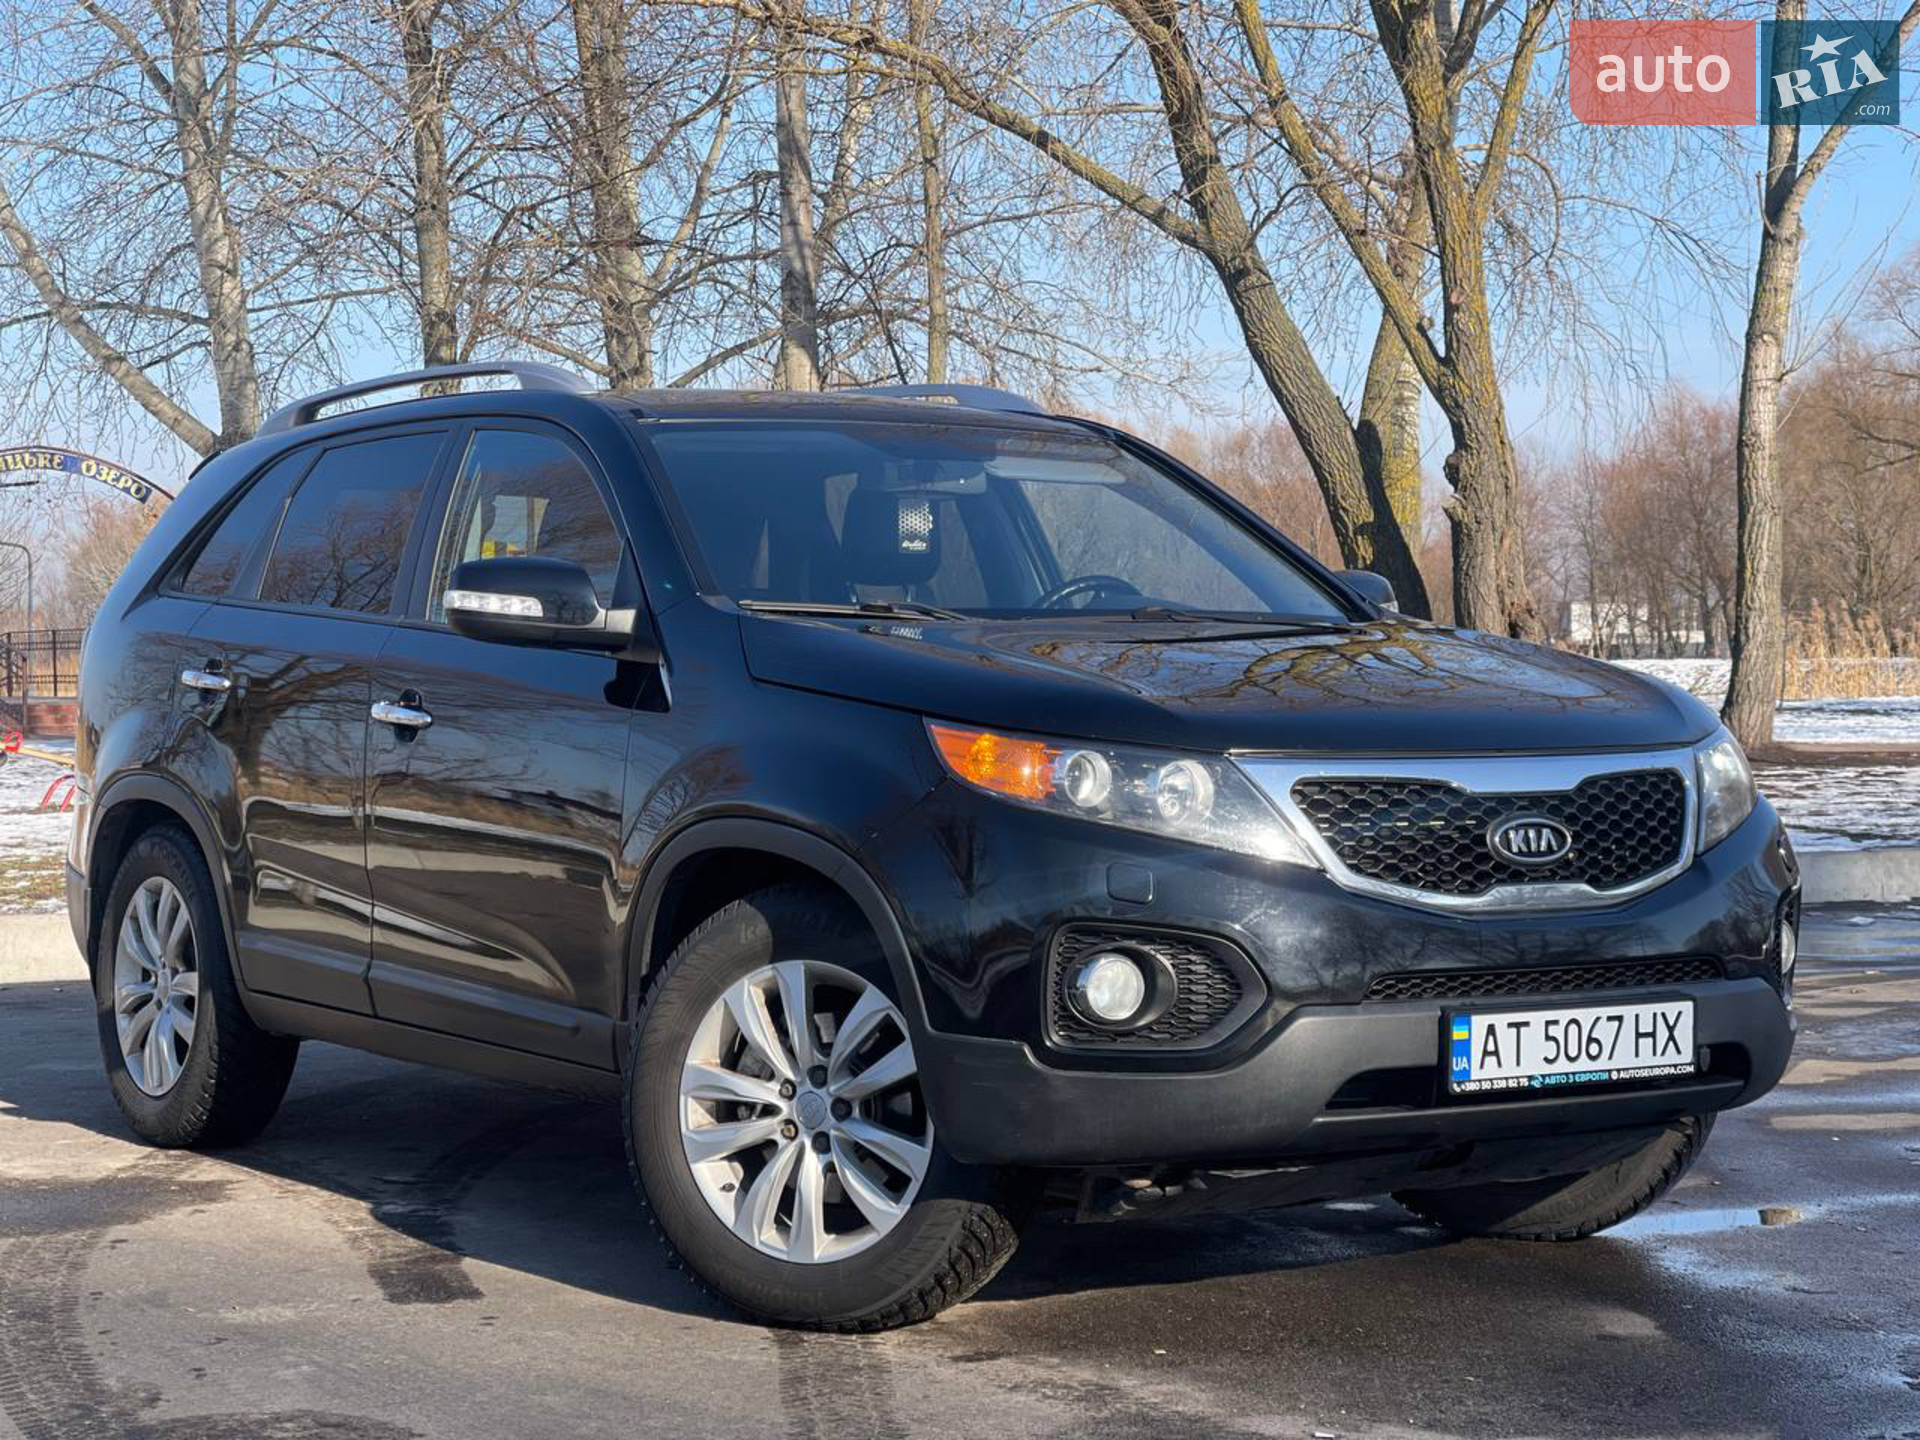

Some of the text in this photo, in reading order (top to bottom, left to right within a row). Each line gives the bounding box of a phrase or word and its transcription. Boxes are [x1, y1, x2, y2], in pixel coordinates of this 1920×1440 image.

[81, 459, 145, 498] ОЗЕРО
[1508, 827, 1559, 853] KIA
[1479, 1010, 1683, 1069] AT 5067 HX
[1453, 1056, 1470, 1071] UA
